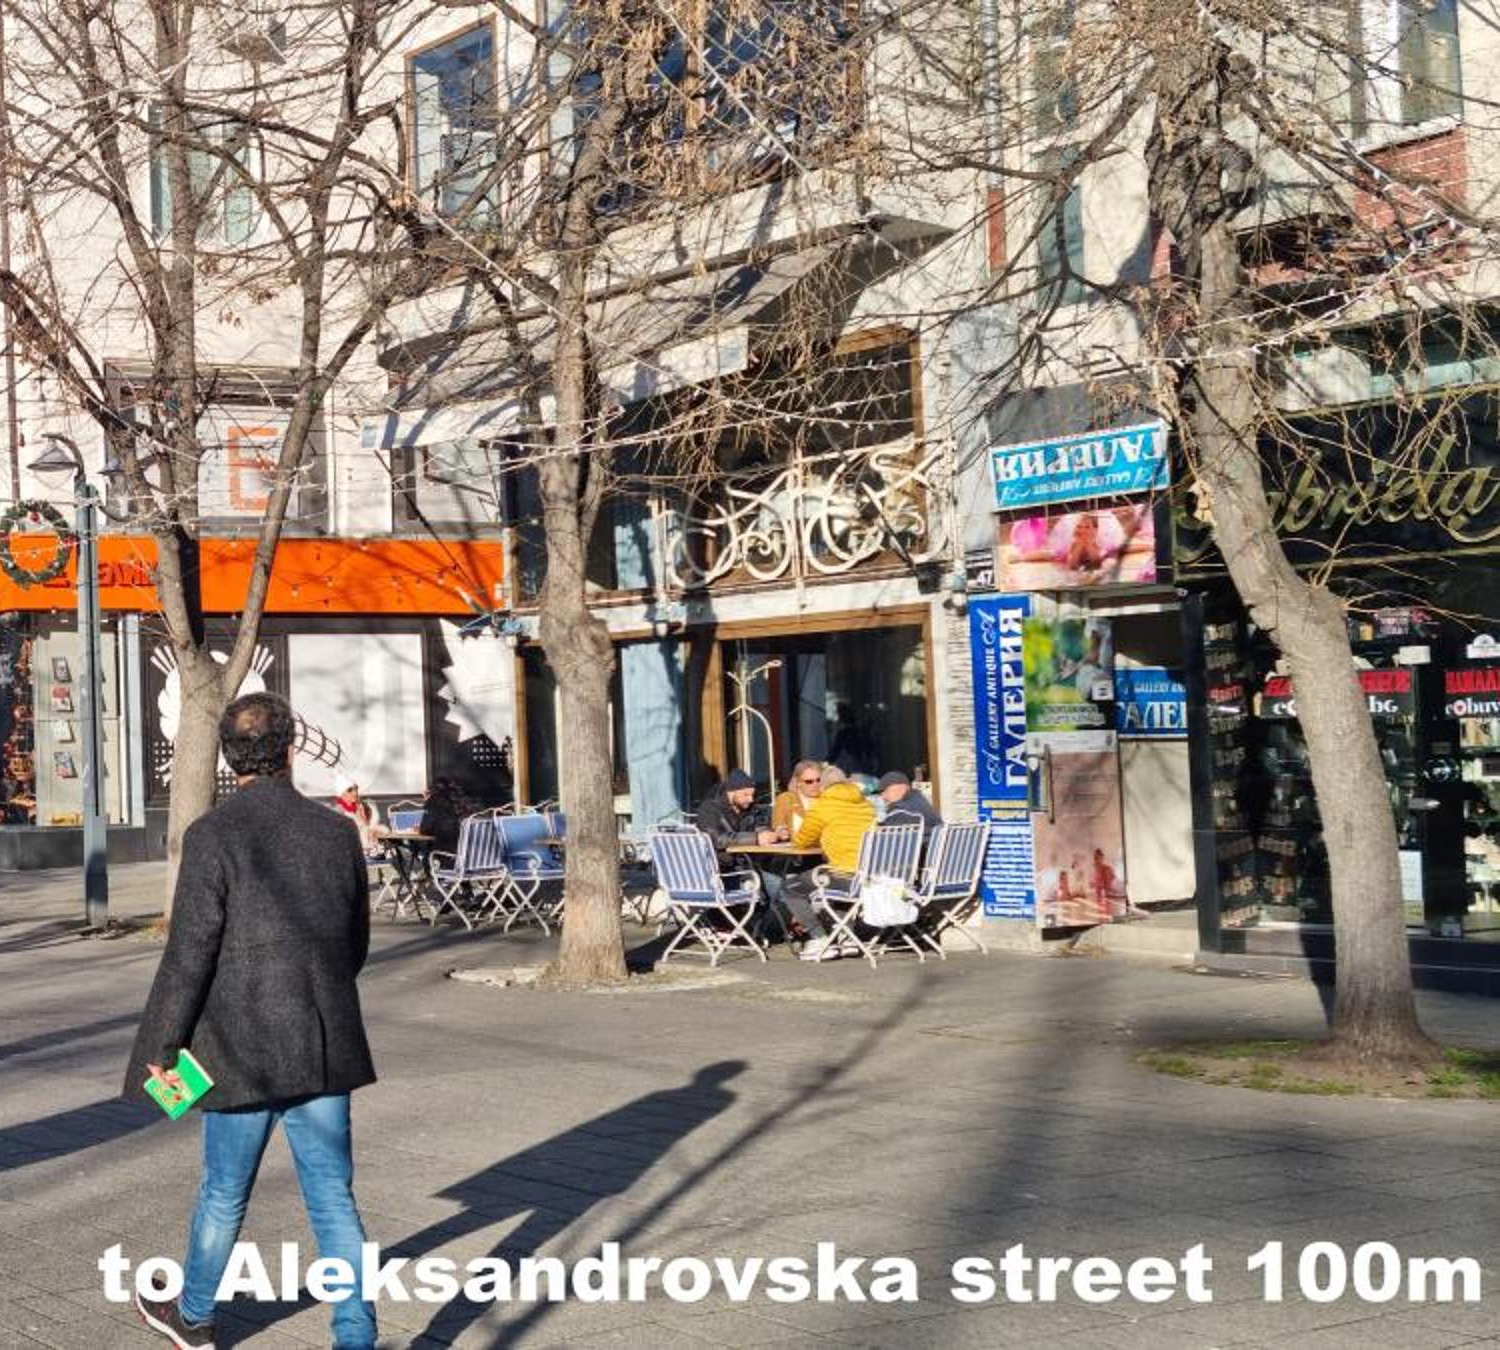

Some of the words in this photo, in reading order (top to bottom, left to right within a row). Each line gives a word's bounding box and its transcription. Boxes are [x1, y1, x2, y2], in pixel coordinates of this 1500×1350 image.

[996, 430, 1167, 482] ГАЛЕРИЯ
[985, 647, 997, 698] ANTIQUE
[999, 607, 1029, 787] ГАЛЕРИЯ
[987, 702, 1000, 749] GALLERY
